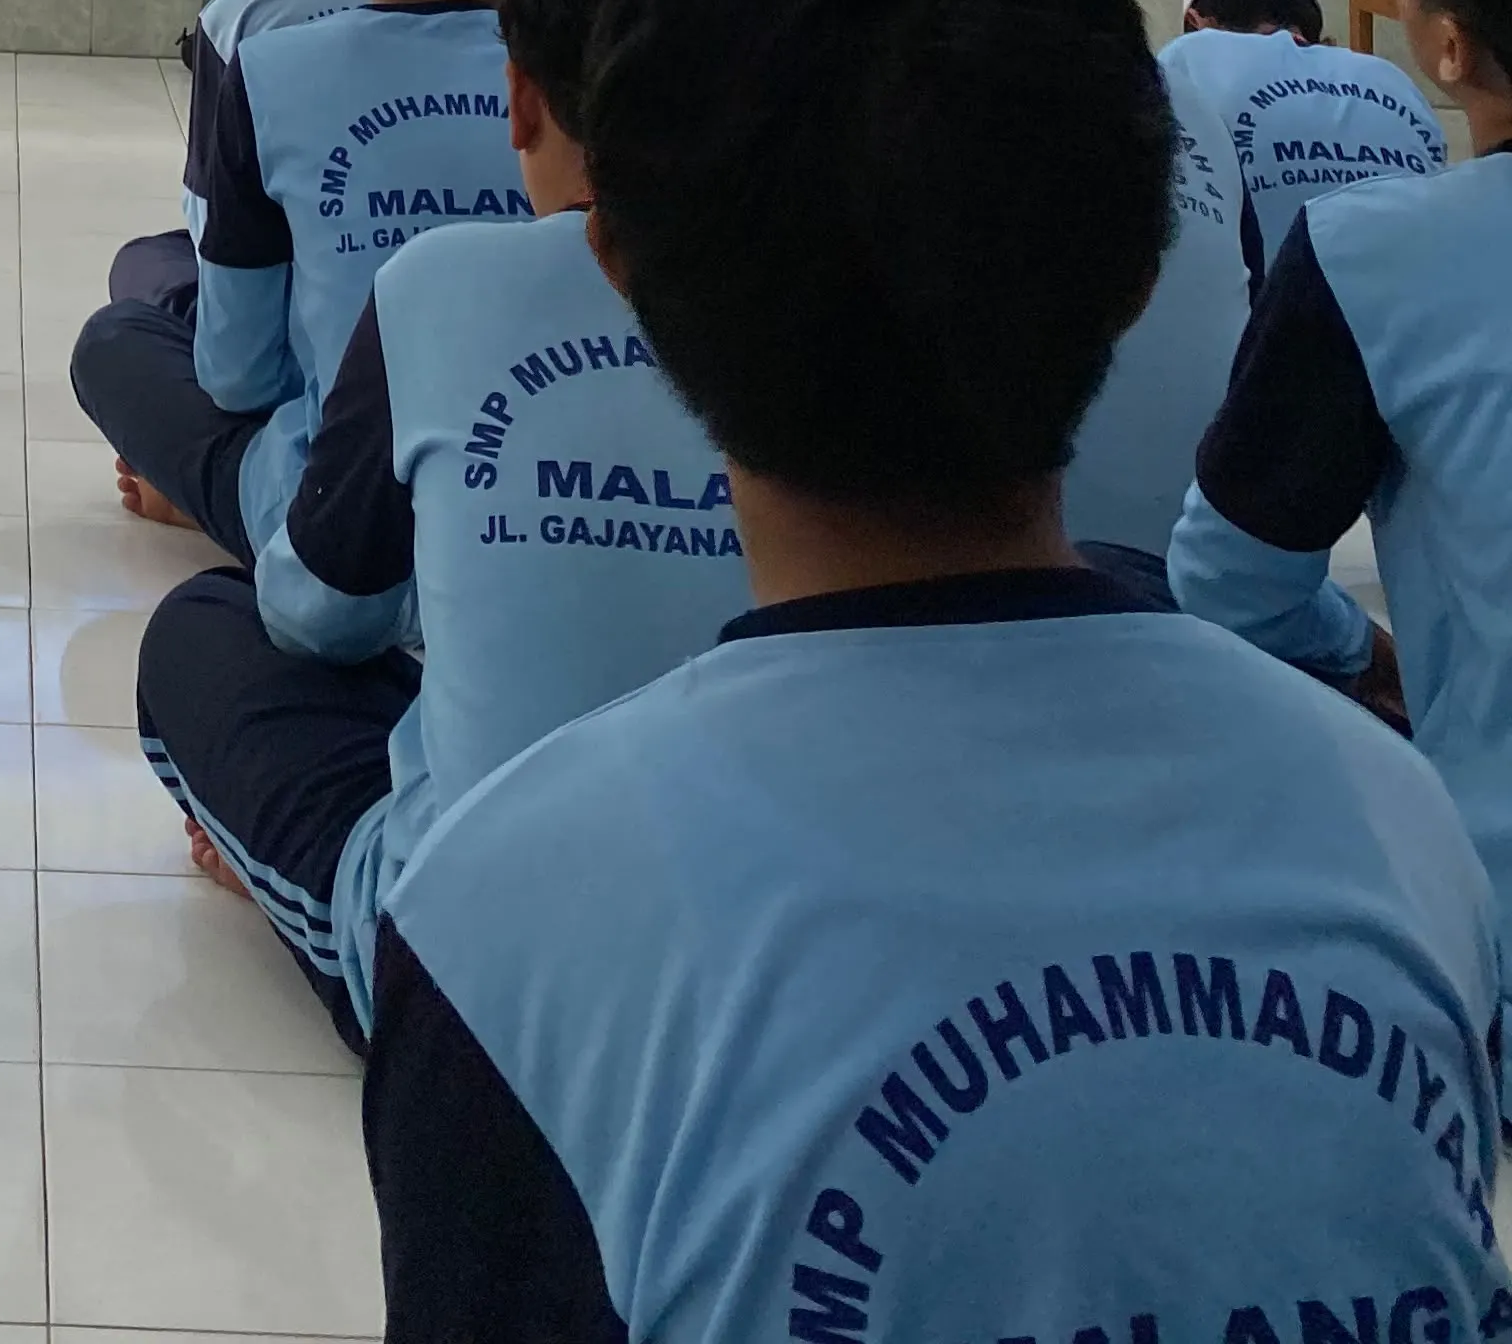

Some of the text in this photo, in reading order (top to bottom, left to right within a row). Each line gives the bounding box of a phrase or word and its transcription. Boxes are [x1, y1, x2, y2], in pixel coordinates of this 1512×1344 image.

[1233, 112, 1256, 165] SMP
[1249, 78, 1446, 163] MUHAMMADIYAH
[1273, 141, 1427, 174] MALANG
[320, 146, 354, 217] SMP
[368, 188, 536, 218] MALAN
[1250, 169, 1382, 193] JL. GAJAYAN
[335, 233, 366, 254] JL.
[465, 392, 514, 490] SMP
[536, 460, 736, 510] MALA
[480, 515, 744, 557] JL. GAJAYANA
[788, 1187, 883, 1344] MP
